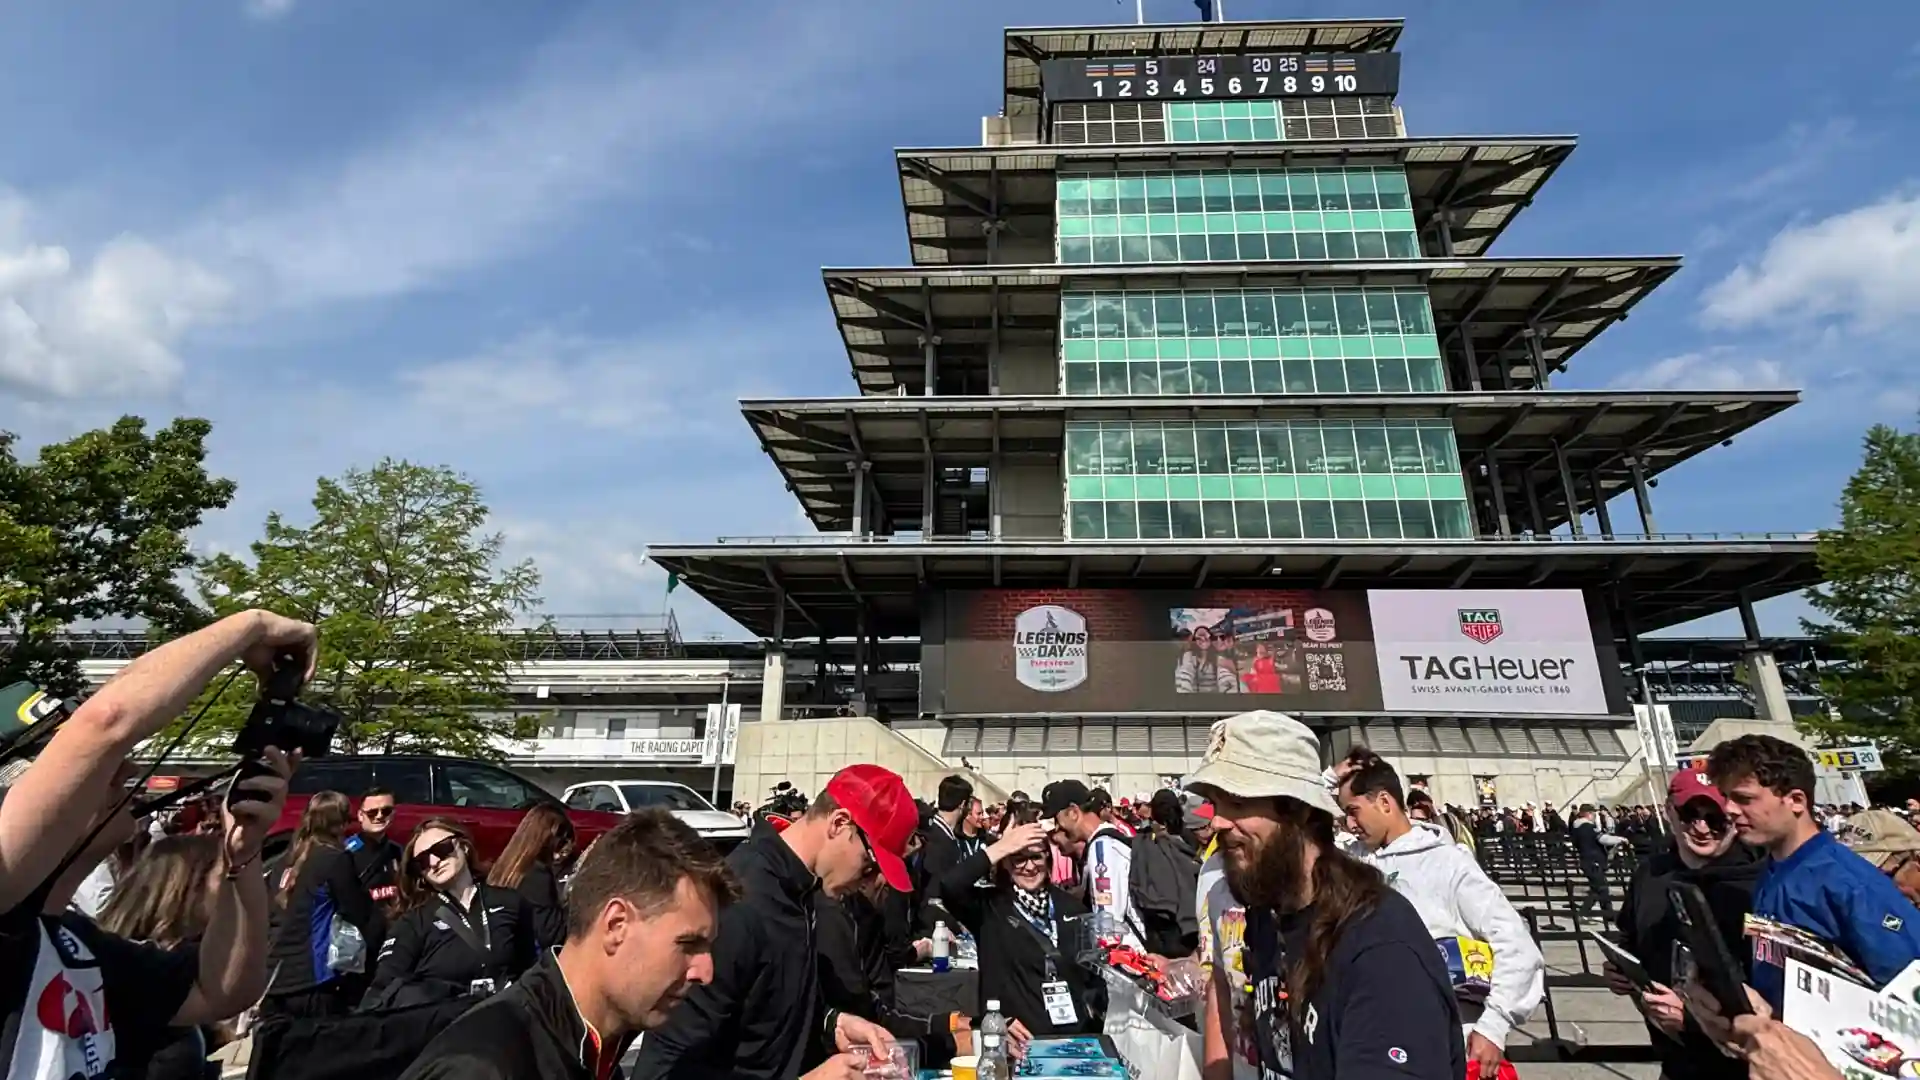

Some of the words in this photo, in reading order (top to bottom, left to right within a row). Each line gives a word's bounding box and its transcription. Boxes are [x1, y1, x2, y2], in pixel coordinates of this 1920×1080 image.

[1145, 60, 1158, 75] 5
[1197, 59, 1216, 74] 24
[1252, 58, 1271, 73] 20
[1279, 57, 1298, 72] 25
[1092, 80, 1103, 97] 1
[1118, 80, 1132, 97] 2
[1145, 79, 1159, 96] 3
[1173, 78, 1187, 95] 4
[1200, 78, 1214, 95] 5
[1228, 77, 1242, 94] 6
[1255, 76, 1269, 93] 7
[1283, 76, 1297, 93] 8
[1311, 75, 1325, 92] 9
[1334, 74, 1357, 92] 10
[1463, 612, 1497, 622] TAG
[1016, 631, 1086, 645] LEGENDS
[1463, 624, 1499, 640] HEUER
[1037, 645, 1068, 658] DAY
[1411, 685, 1440, 694] SWISS
[1444, 685, 1513, 694] AVANT-GARDE
[1516, 685, 1545, 694] SINCE
[1549, 685, 1571, 694] 1860
[631, 741, 645, 753] THE
[647, 741, 679, 753] RACING
[680, 741, 705, 753] CAPIT
